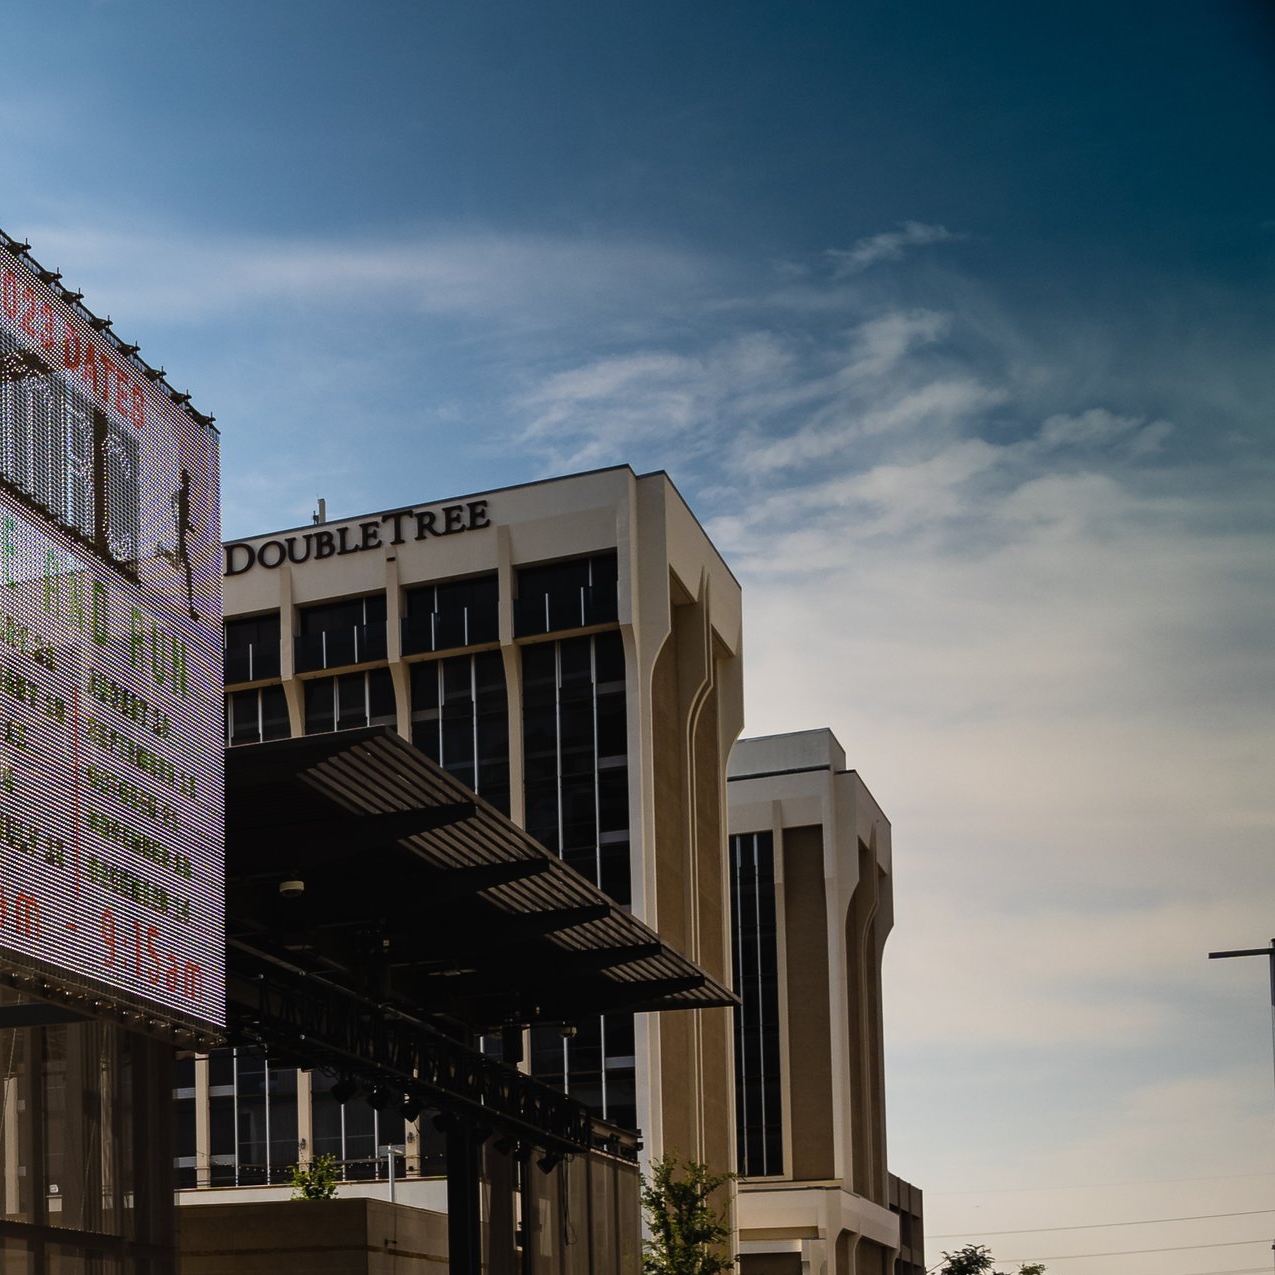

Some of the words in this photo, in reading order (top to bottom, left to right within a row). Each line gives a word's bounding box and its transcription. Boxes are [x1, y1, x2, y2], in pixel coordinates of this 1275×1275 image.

[64, 322, 145, 432] DATES
[222, 500, 491, 577] DOUBLETREE
[45, 545, 107, 648] AND
[131, 605, 187, 699] RUN
[101, 906, 203, 1001] 9:15am
